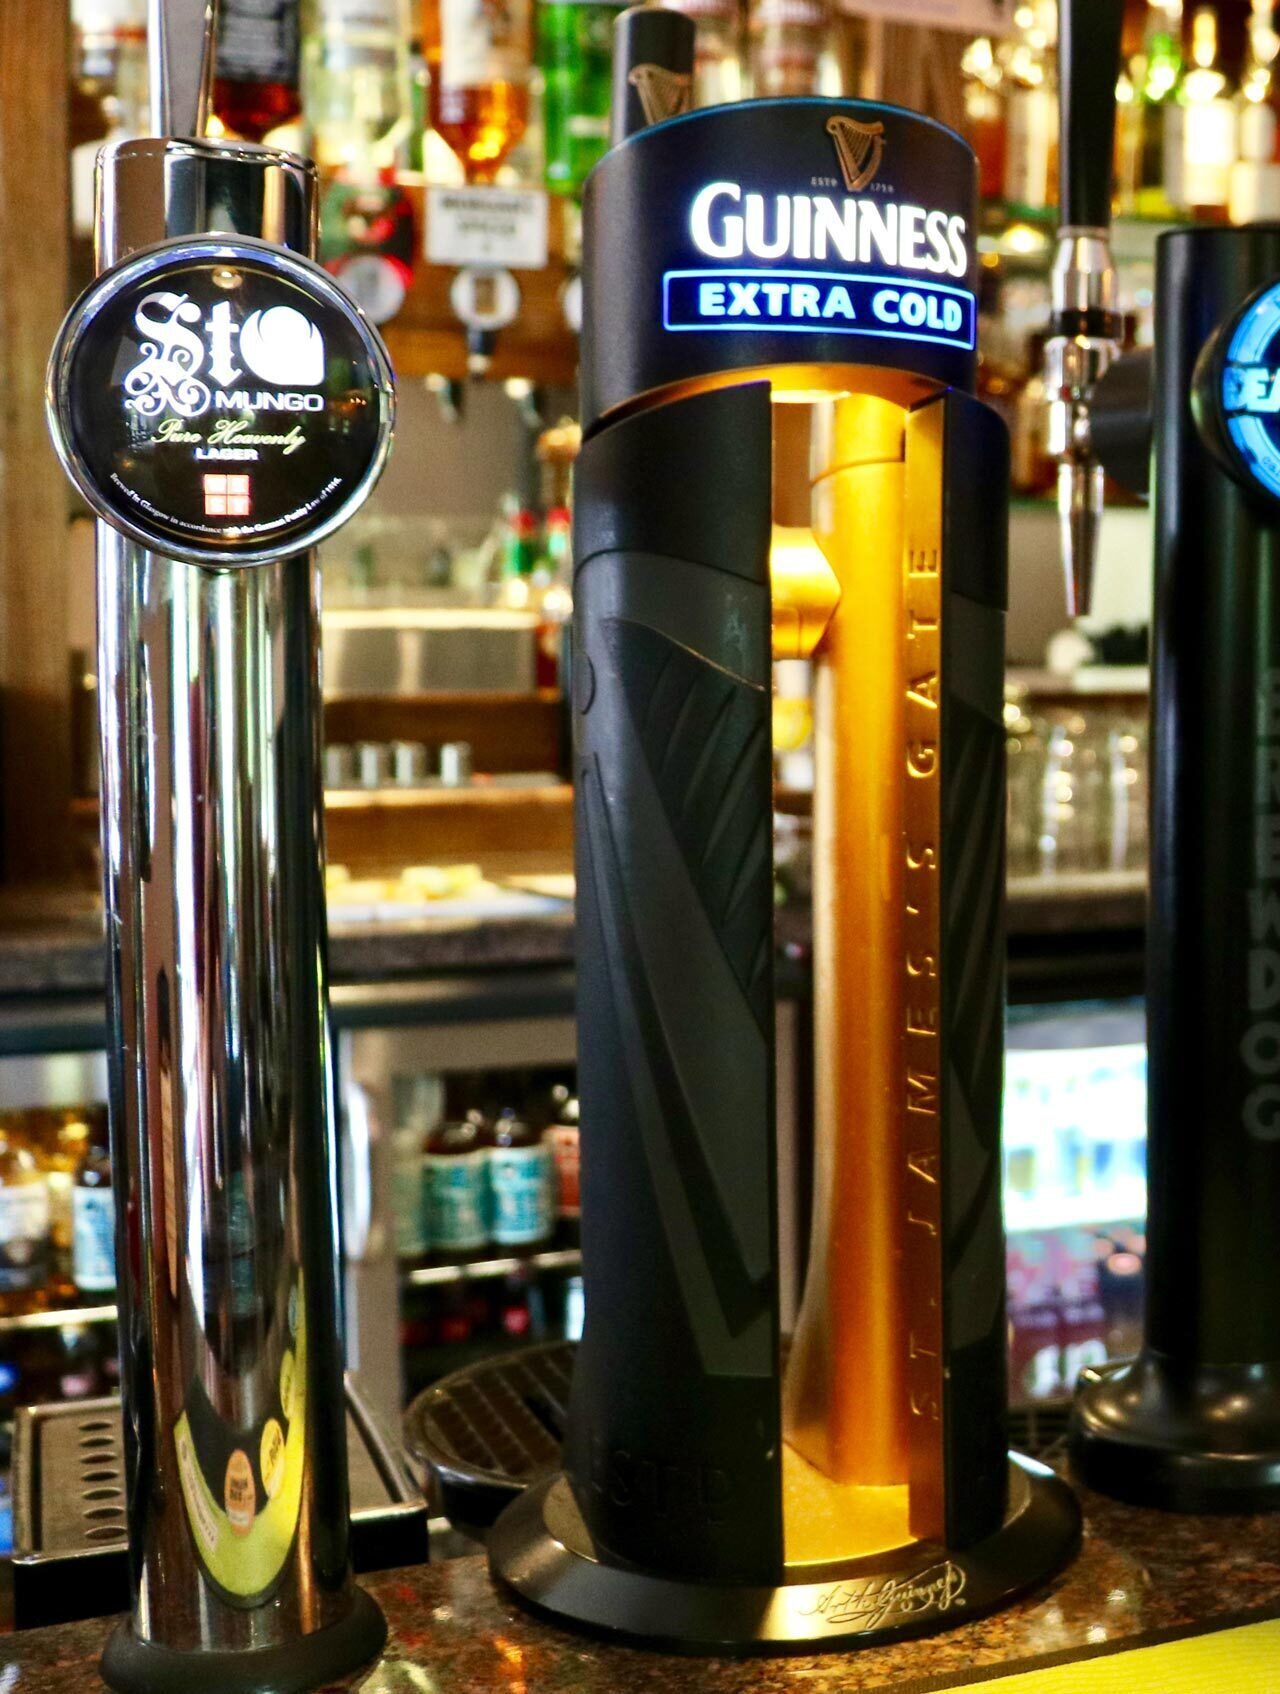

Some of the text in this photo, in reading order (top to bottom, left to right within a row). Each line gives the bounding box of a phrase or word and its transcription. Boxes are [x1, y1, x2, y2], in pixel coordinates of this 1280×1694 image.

[690, 181, 968, 278] GUINNESS
[699, 282, 964, 331] EXTRA COLD
[215, 390, 325, 412] MUNGO
[151, 418, 307, 455] Pure Heavenly
[195, 447, 258, 460] LAGER
[906, 548, 939, 779] GATE
